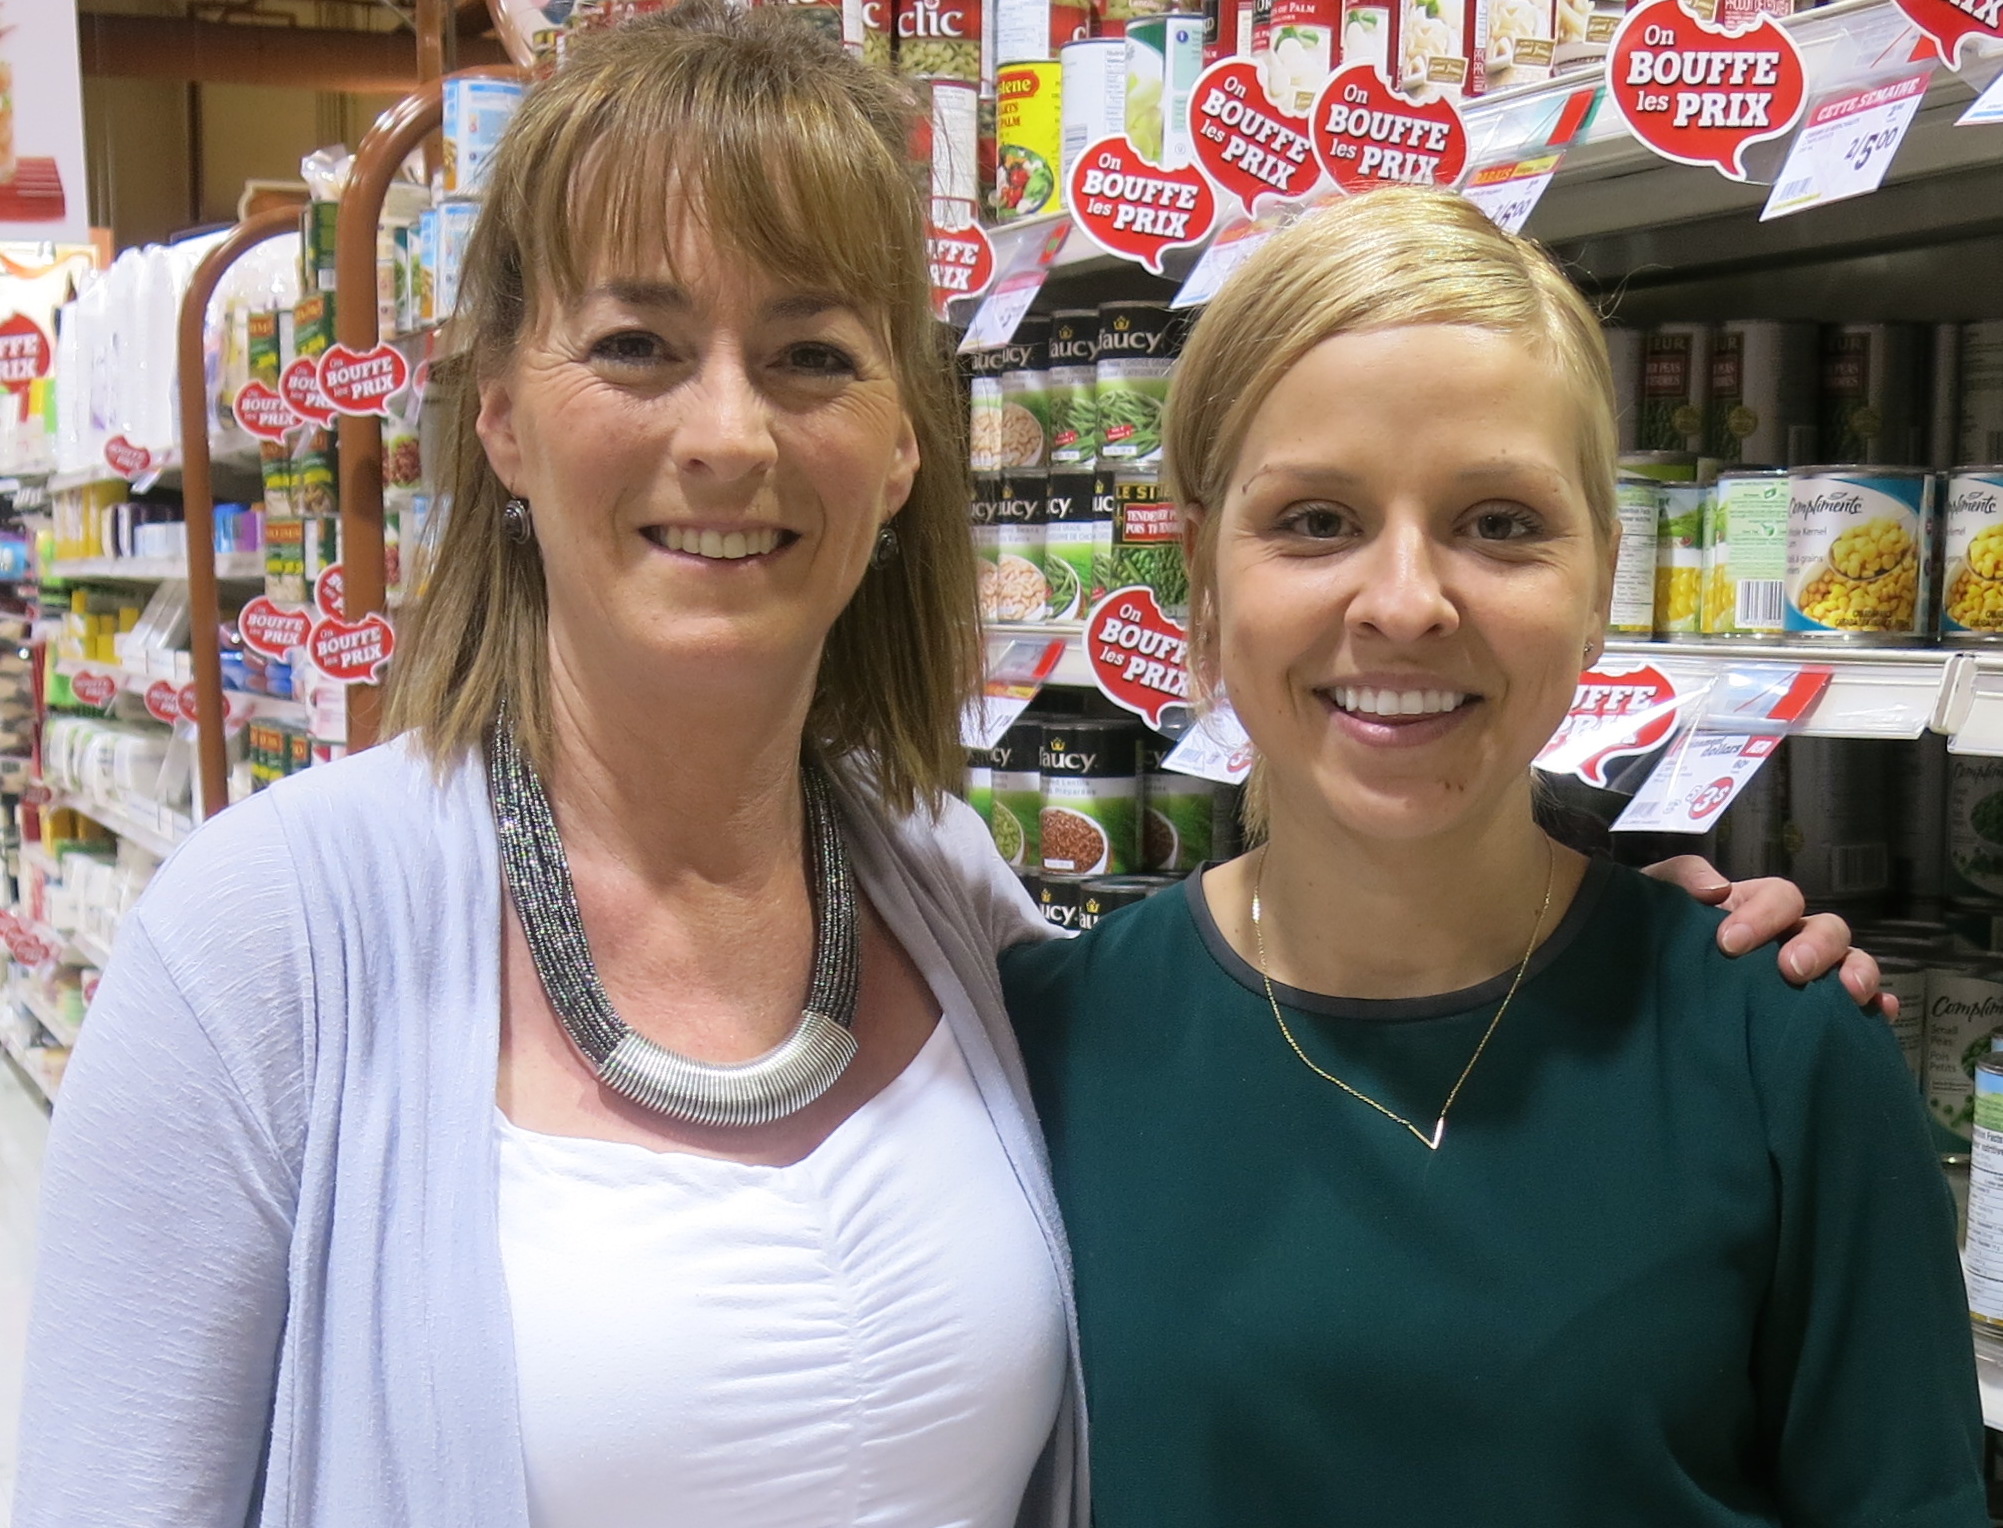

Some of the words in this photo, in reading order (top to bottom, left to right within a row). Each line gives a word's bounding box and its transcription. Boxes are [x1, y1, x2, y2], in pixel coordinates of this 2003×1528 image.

[898, 1, 964, 38] clic
[1644, 25, 1674, 45] On
[1627, 50, 1779, 85] BOUFFE
[1223, 76, 1246, 98] On
[1344, 84, 1368, 104] On
[1817, 101, 1857, 121] CETTE
[1858, 78, 1920, 108] SEMAINE
[1636, 90, 1669, 112] les
[1673, 92, 1771, 127] PRIX
[1201, 89, 1312, 163] BOUFFE
[1325, 103, 1450, 151] BOUFFE
[1099, 153, 1121, 171] On
[1200, 119, 1225, 143] les
[1221, 137, 1297, 191] PRIX
[1330, 139, 1356, 159] les
[1357, 146, 1439, 186] PRIX
[1082, 169, 1198, 210] BOUFFE
[1086, 198, 1112, 217] les
[1113, 205, 1190, 239] PRIX
[326, 356, 393, 387] BOUFFE
[352, 374, 394, 399] PRIX
[258, 412, 295, 426] PRIX
[247, 614, 304, 631] BOUFFE
[1119, 604, 1142, 622] On
[262, 629, 299, 645] PRIX
[317, 626, 381, 656] BOUFFE
[341, 643, 382, 668] PRIX
[1100, 646, 1125, 666] les
